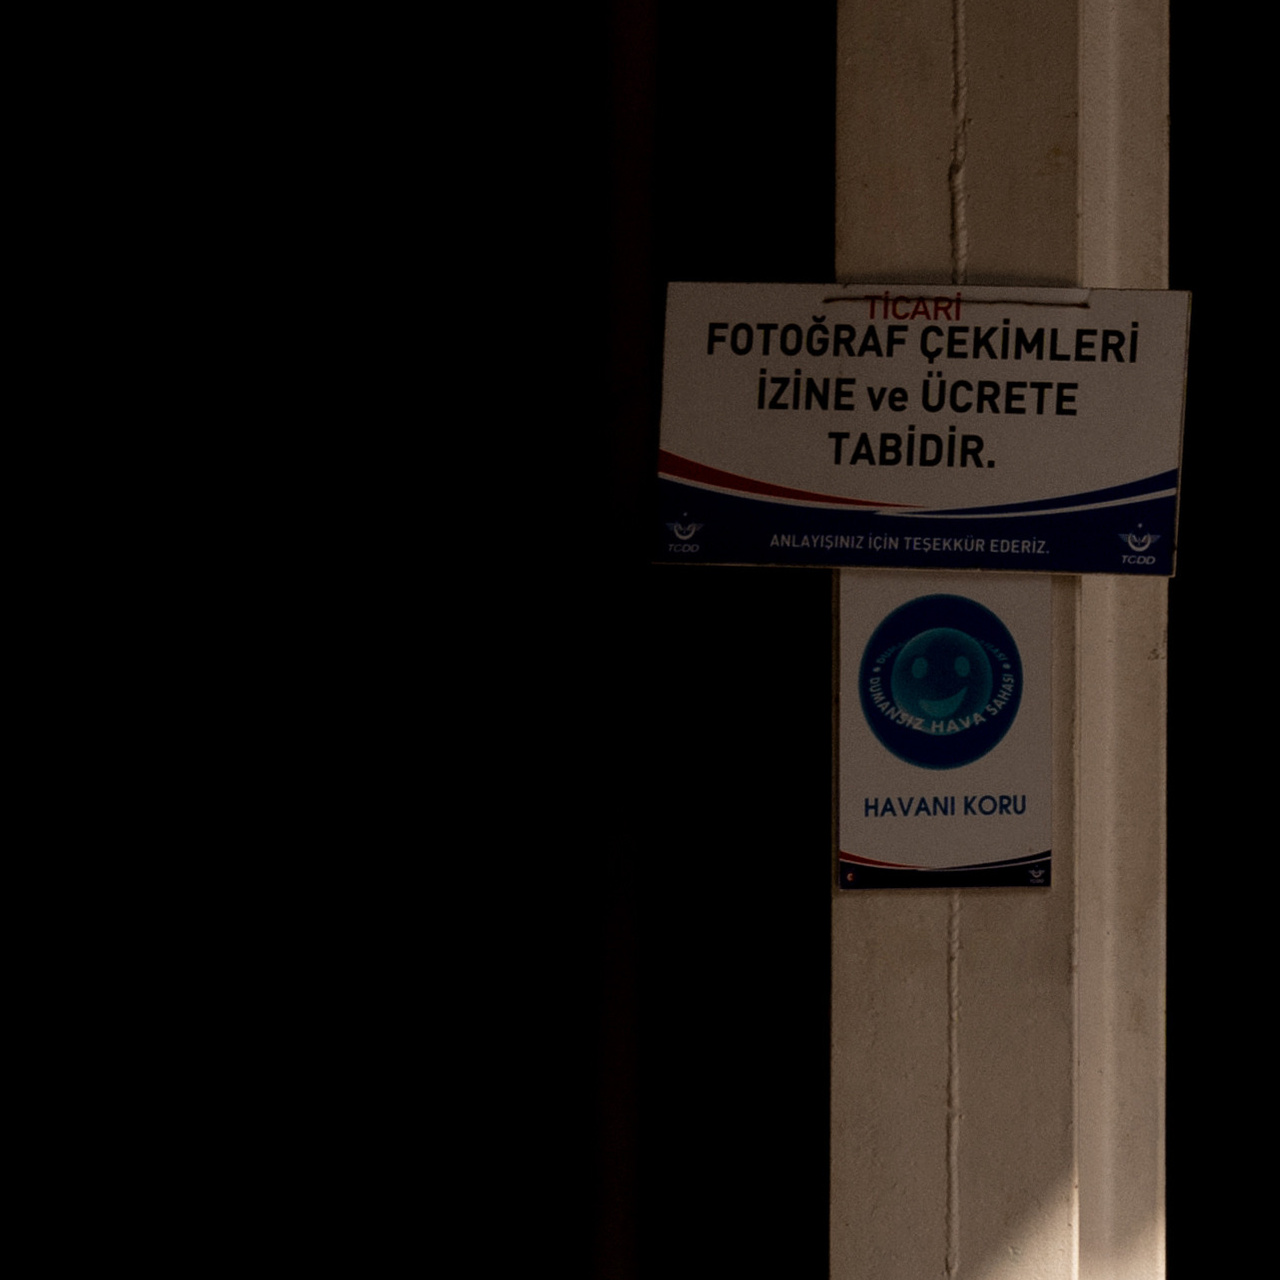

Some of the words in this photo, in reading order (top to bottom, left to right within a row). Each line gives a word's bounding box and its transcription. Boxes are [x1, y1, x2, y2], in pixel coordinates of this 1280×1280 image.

[864, 291, 962, 321] TİCARİ
[706, 315, 907, 358] FOTOĞRAF
[919, 318, 1140, 364] ÇEKİMLERİ
[757, 368, 856, 411] İZİNE
[867, 384, 909, 412] ve
[921, 371, 1080, 416] ÜCRETE
[828, 424, 996, 468] TABİDİR.
[667, 542, 700, 554] TCDD
[769, 532, 864, 551] ANLAYIŞINIZ
[868, 532, 900, 552] İÇİN
[903, 534, 986, 553] TEŞEKKÜR
[989, 535, 1050, 555] EDERİZ.
[1121, 553, 1157, 566] TCDD
[868, 676, 924, 732] DUMANSIZ
[930, 712, 987, 733] HAVA
[986, 673, 1015, 716] SAHASI
[864, 796, 956, 817] HAVANI
[963, 794, 1027, 816] KORU
